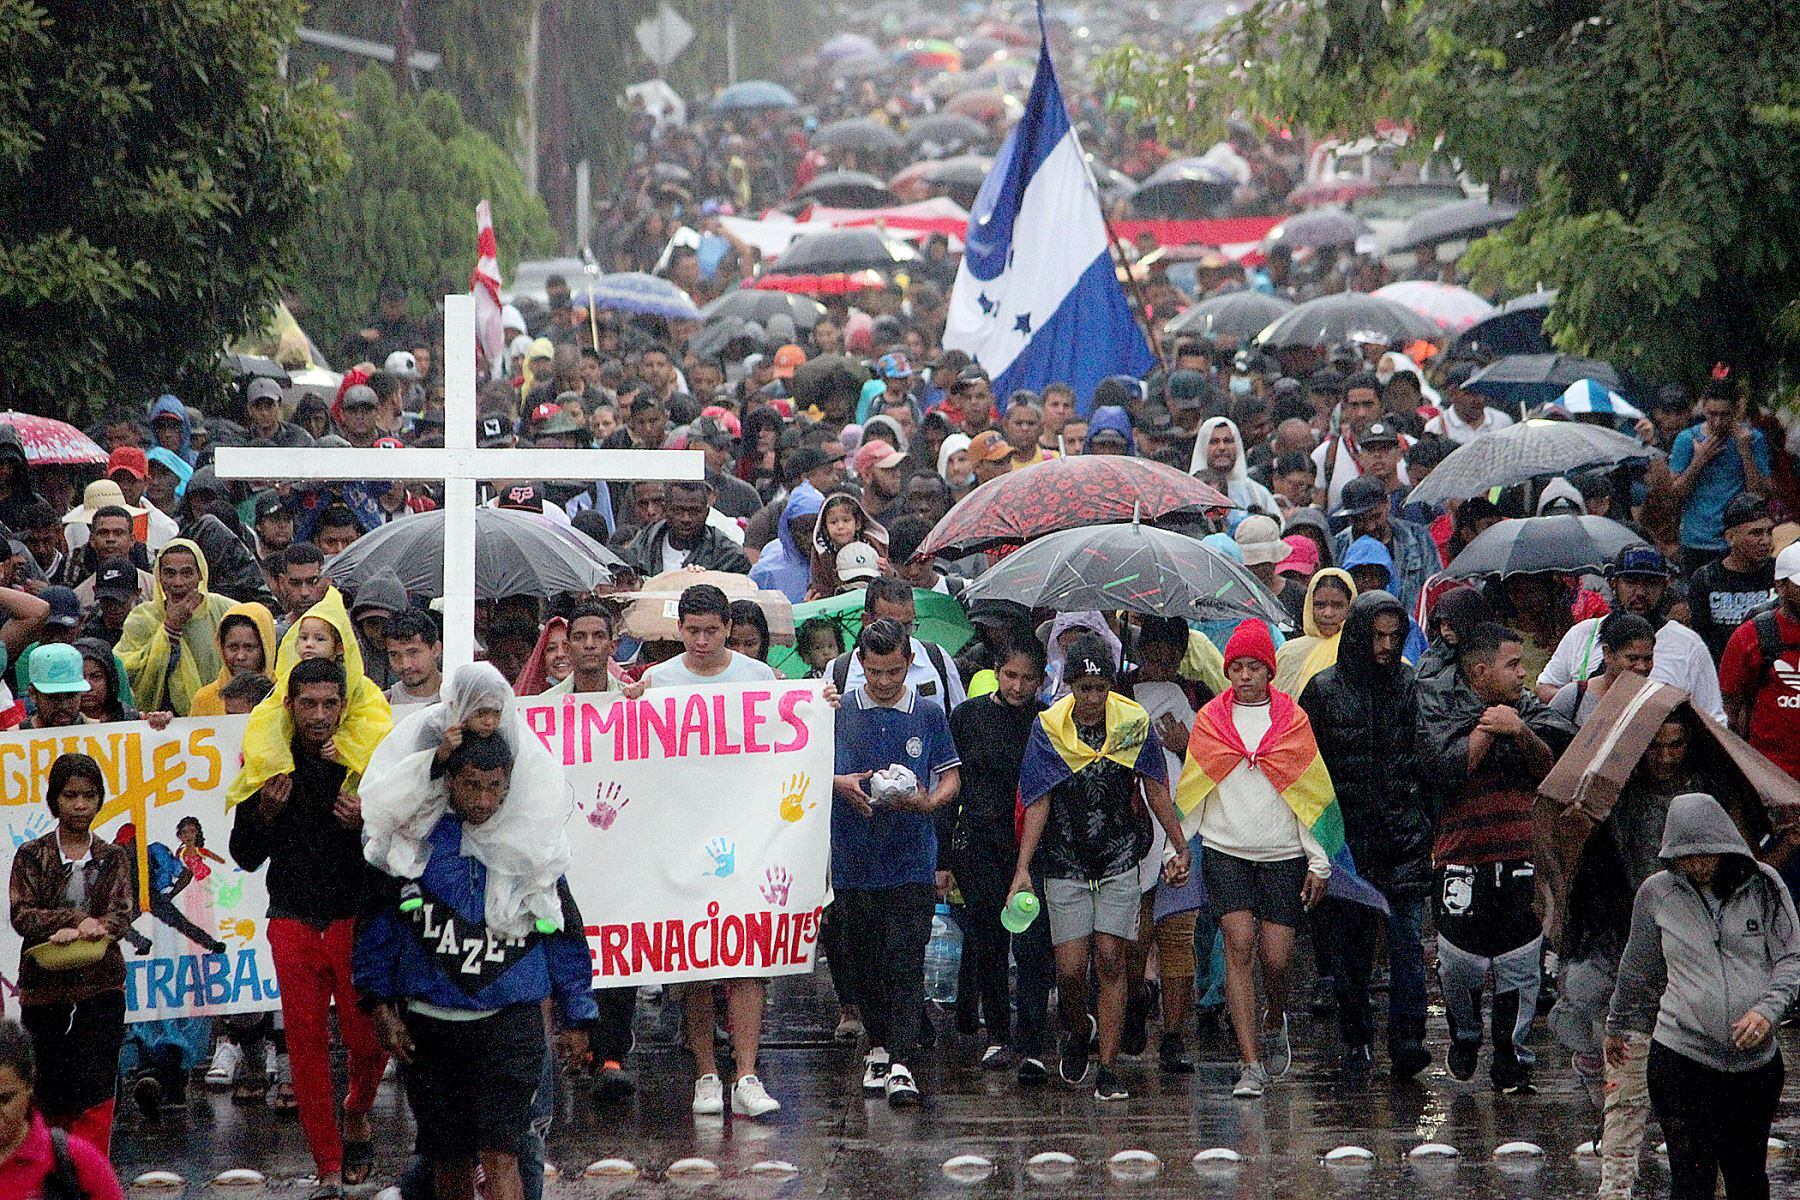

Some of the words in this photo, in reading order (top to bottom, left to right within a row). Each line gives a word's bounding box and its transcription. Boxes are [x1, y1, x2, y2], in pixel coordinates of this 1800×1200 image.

[1083, 658, 1101, 675] LA
[517, 690, 813, 765] RIMINALES
[413, 903, 526, 975] LAZE
